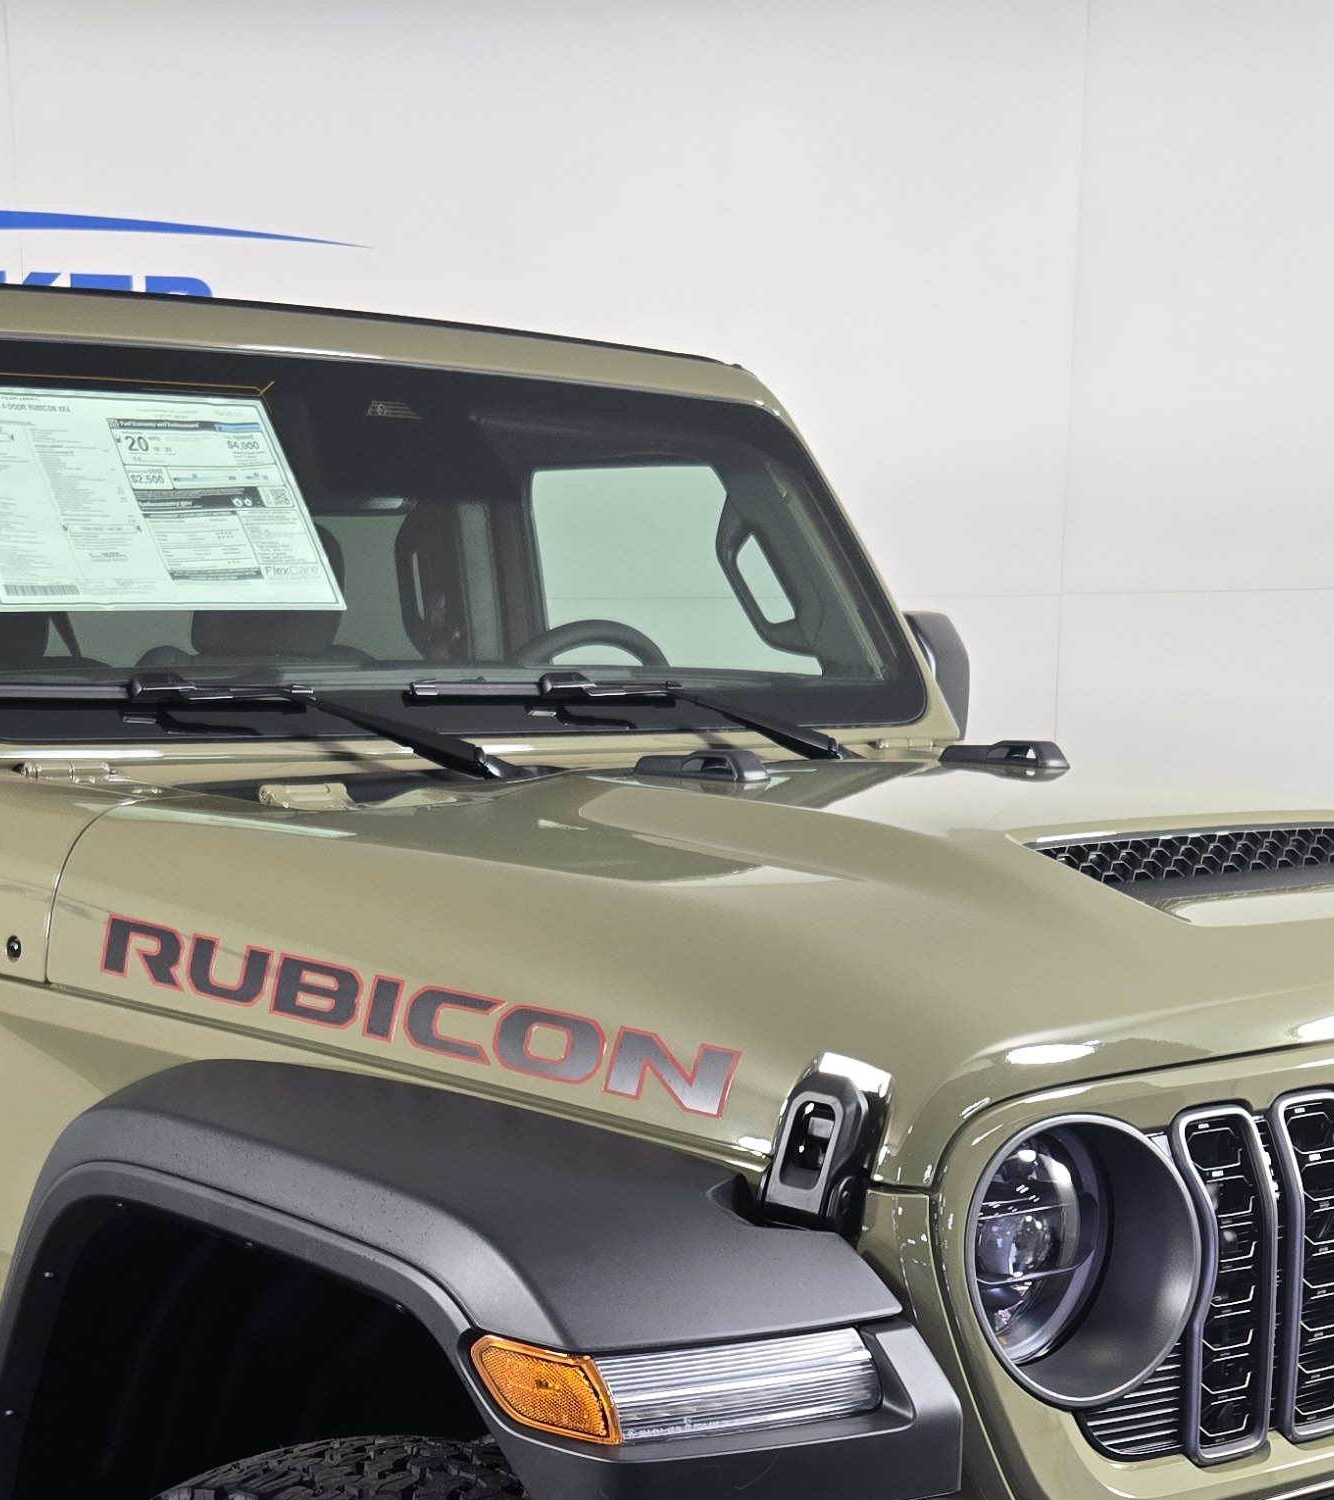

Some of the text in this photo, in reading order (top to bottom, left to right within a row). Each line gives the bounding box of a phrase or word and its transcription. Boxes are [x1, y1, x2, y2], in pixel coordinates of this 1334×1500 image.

[28, 404, 57, 412] RUBICON
[124, 436, 149, 452] 20
[226, 441, 259, 450] $4,000
[130, 474, 164, 485] $2,500
[264, 565, 319, 576] FlexCare
[101, 913, 741, 1119] RUBICON
